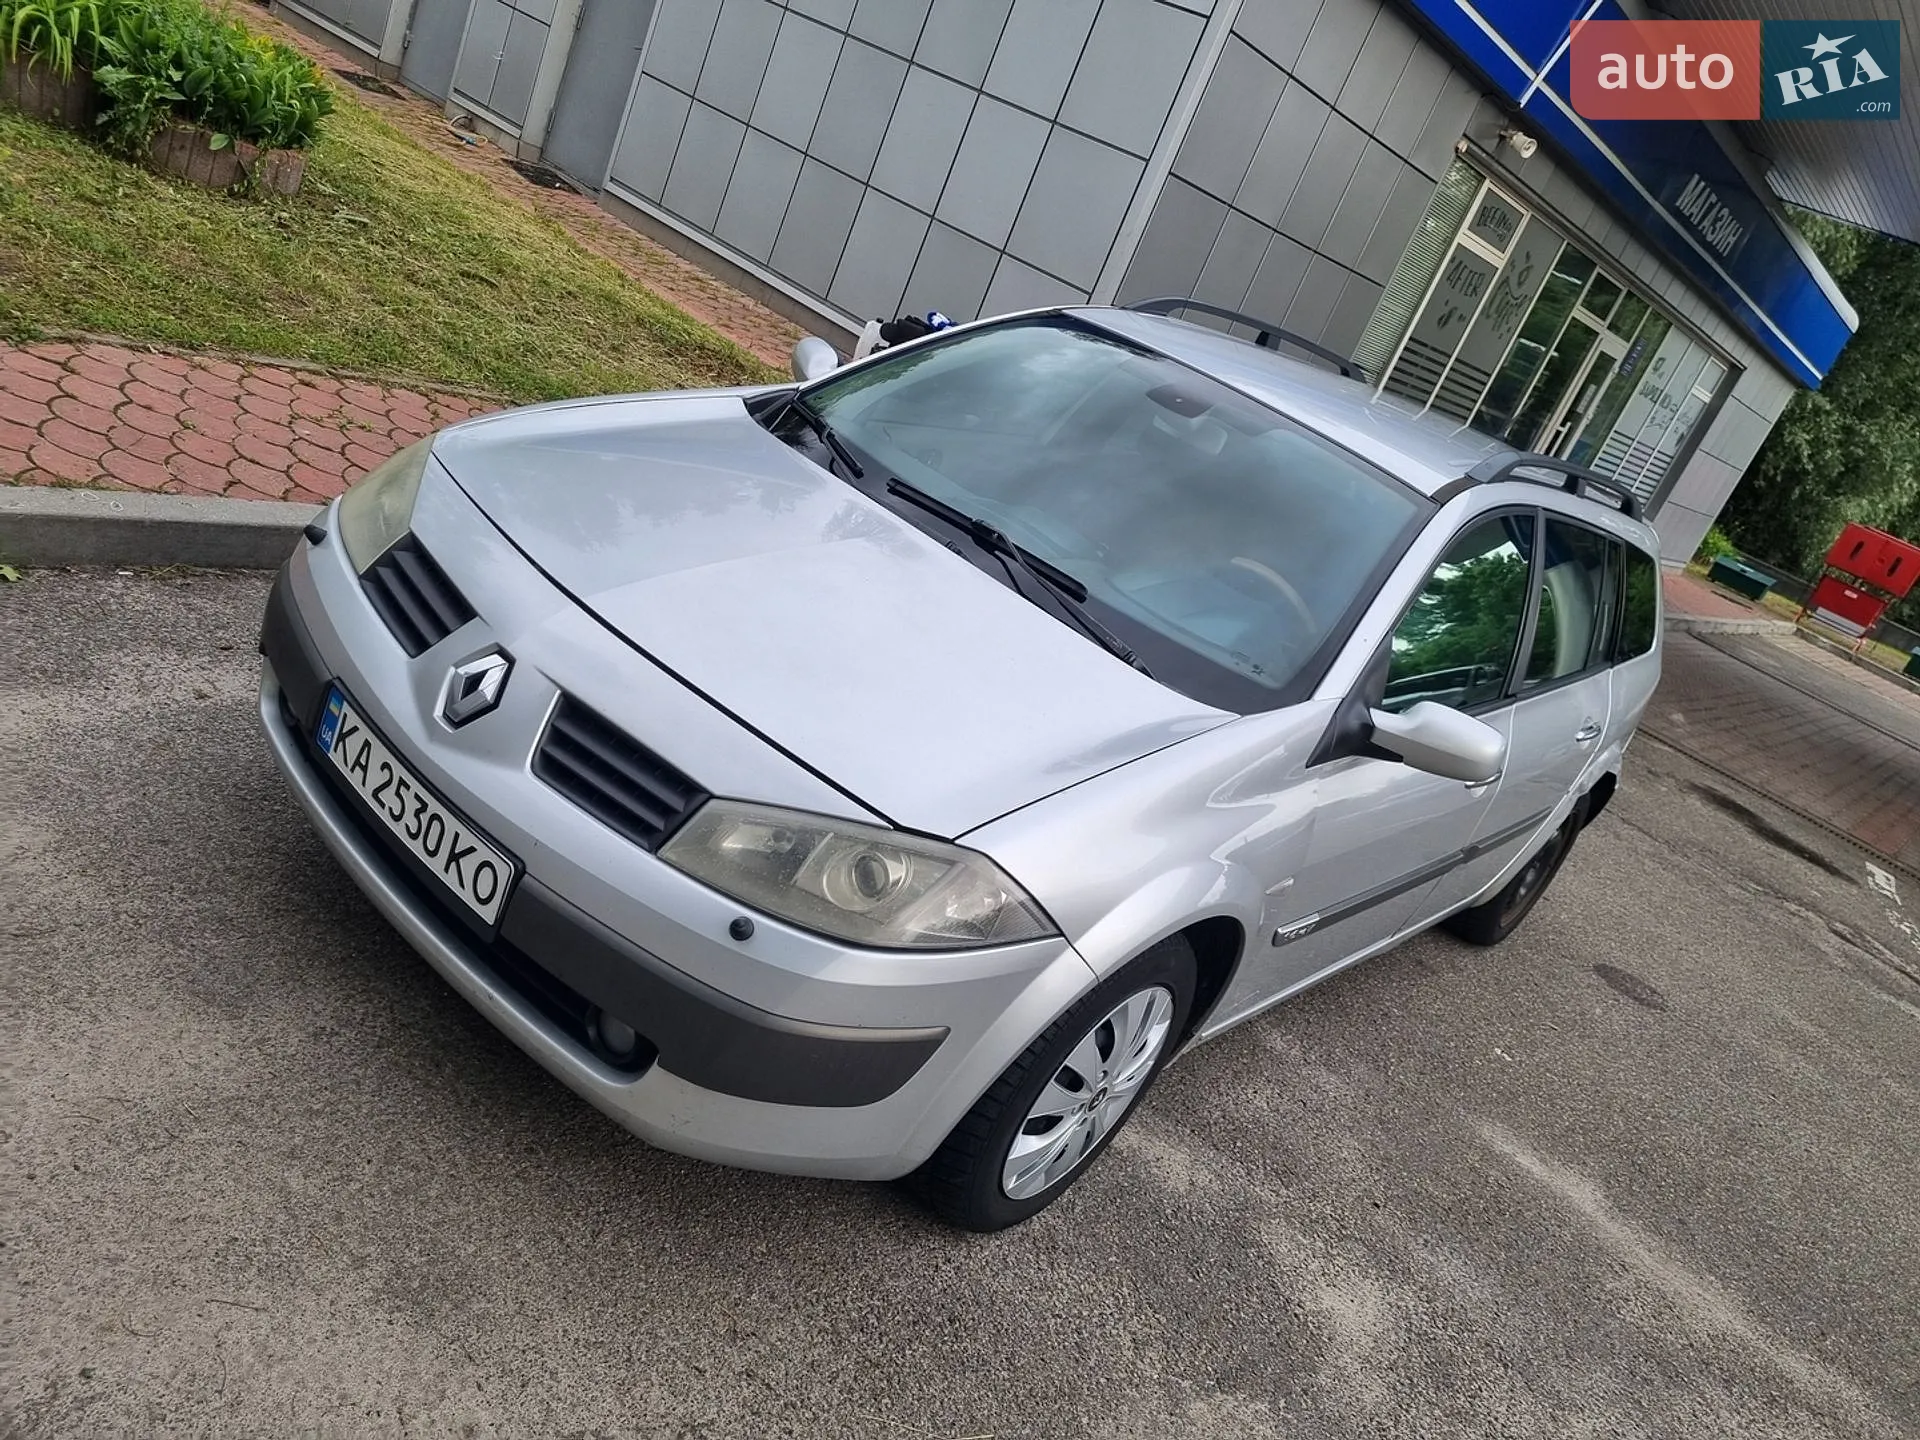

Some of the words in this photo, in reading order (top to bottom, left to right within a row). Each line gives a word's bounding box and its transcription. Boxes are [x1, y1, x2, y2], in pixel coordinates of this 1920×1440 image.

[1675, 173, 1744, 257] МАГАЗИН
[1446, 260, 1486, 298] AFTER
[321, 724, 332, 746] UA
